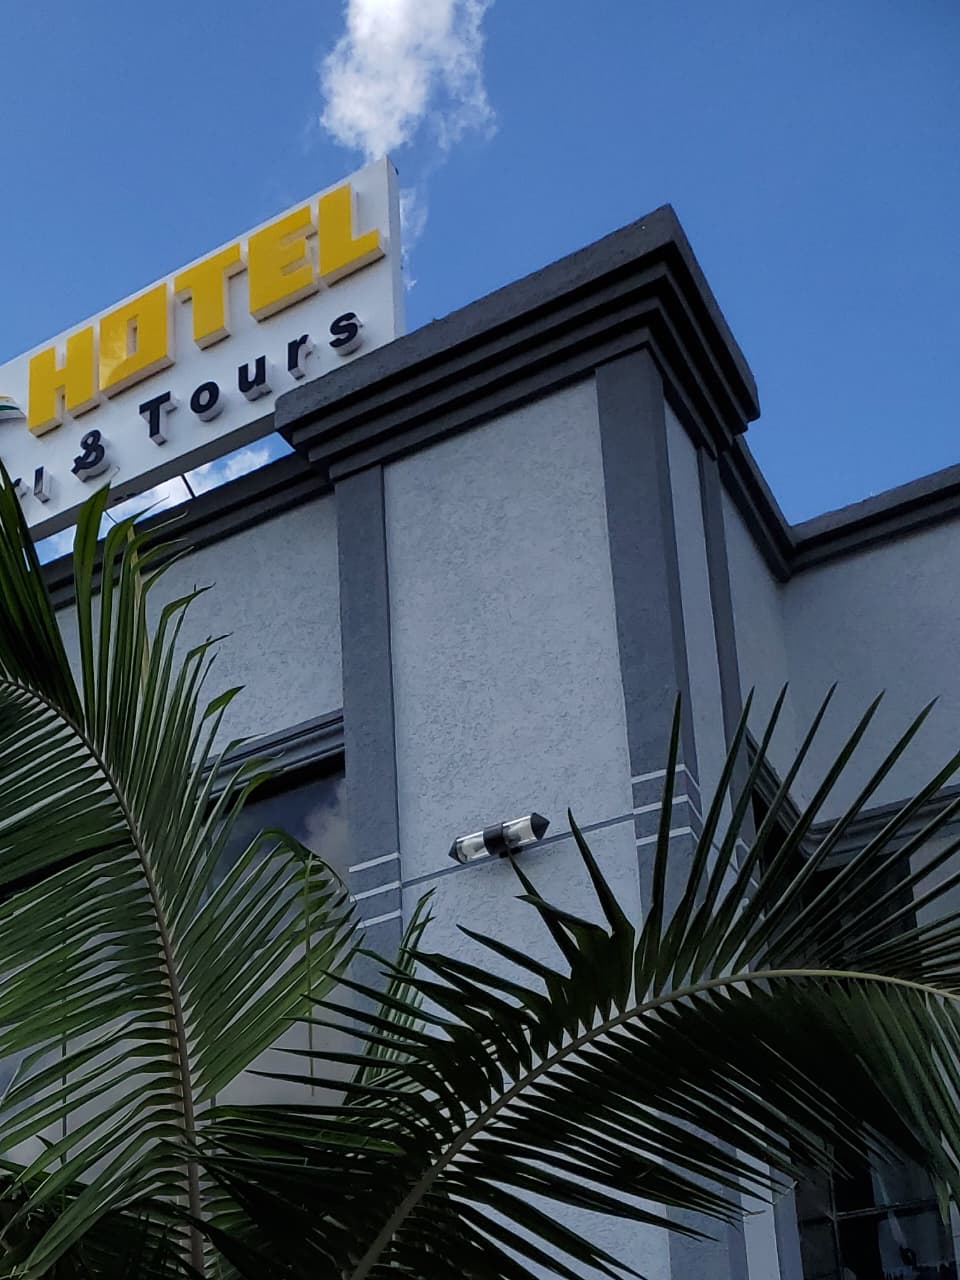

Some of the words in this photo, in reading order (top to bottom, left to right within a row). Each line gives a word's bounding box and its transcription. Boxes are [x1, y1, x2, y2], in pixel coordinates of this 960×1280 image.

[26, 183, 382, 436] HOTEL
[71, 429, 106, 475] &
[138, 311, 359, 442] Tours
